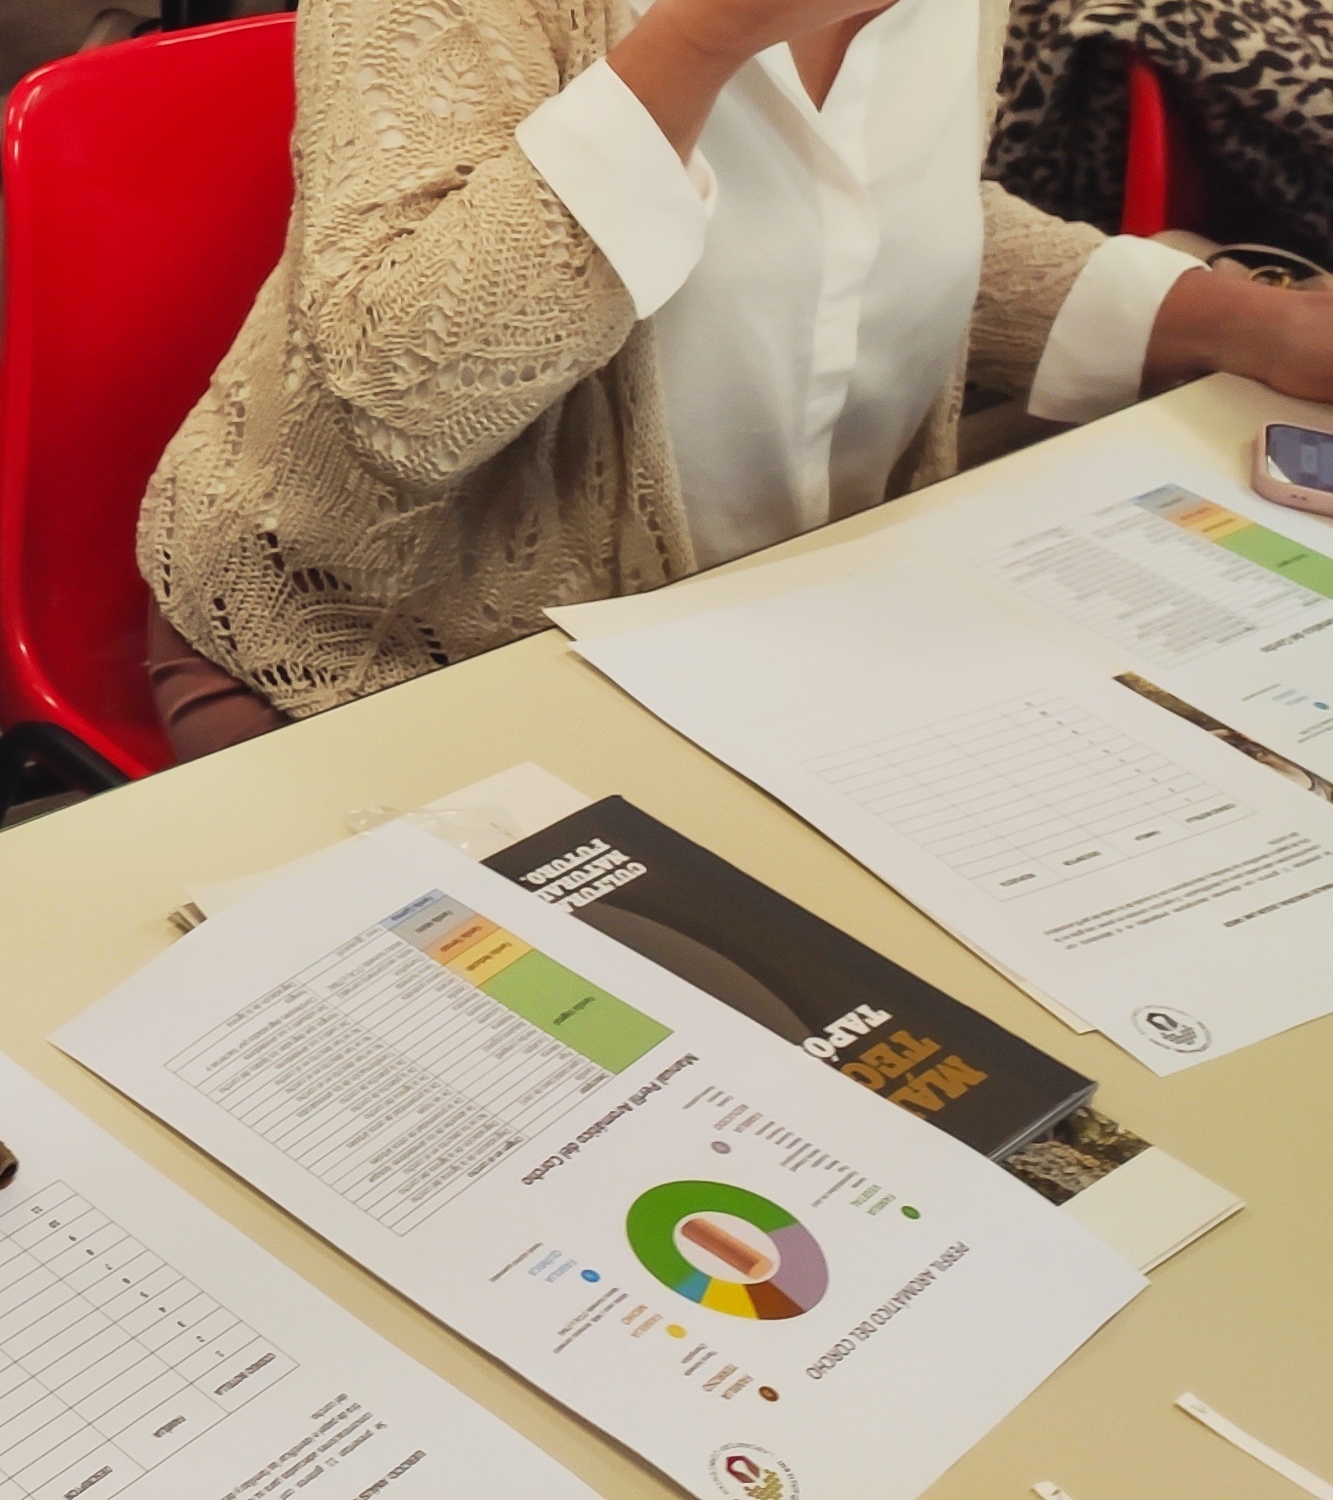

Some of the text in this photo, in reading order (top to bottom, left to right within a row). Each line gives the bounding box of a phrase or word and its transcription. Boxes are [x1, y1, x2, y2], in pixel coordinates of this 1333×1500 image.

[796, 1004, 891, 1064] TAPÓ
[655, 1053, 699, 1086] Manual
[887, 1055, 987, 1121] MA
[628, 1081, 662, 1106] Perfil
[575, 1102, 633, 1144] Aromático
[558, 1141, 580, 1160] del
[521, 1154, 565, 1186] Corcho
[805, 1241, 970, 1380] PERFIL AROMÁTICO DEL CORCHO
